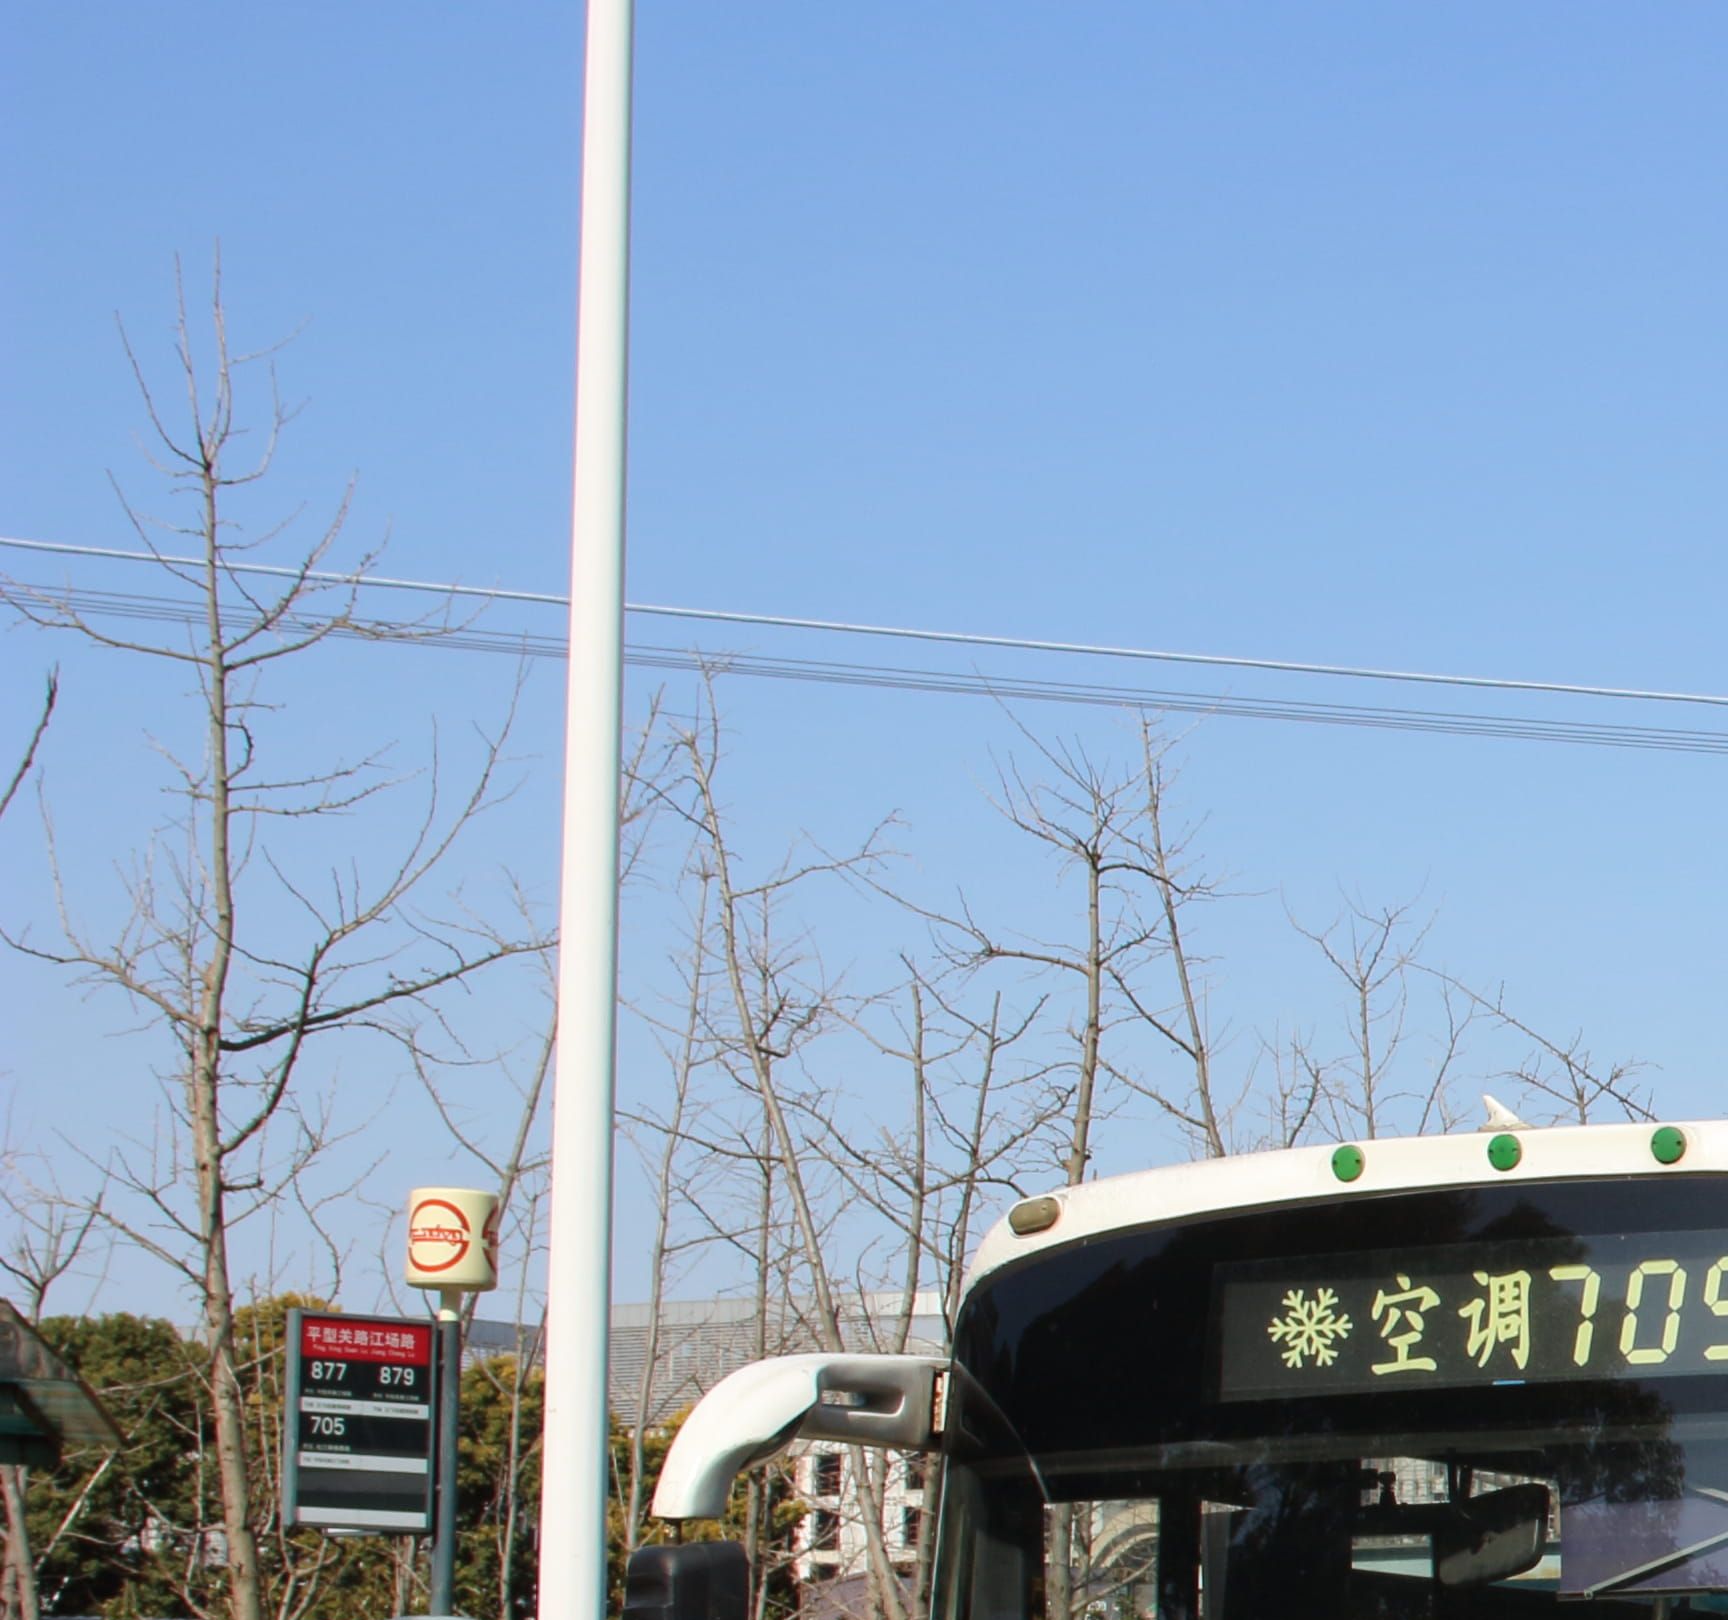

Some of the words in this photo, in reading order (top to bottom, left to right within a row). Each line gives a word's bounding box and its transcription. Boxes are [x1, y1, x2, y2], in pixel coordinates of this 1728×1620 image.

[306, 1325, 416, 1350] 平型关路江场路
[311, 1361, 347, 1381] 877
[379, 1366, 414, 1386] 879
[310, 1416, 345, 1436] 705
